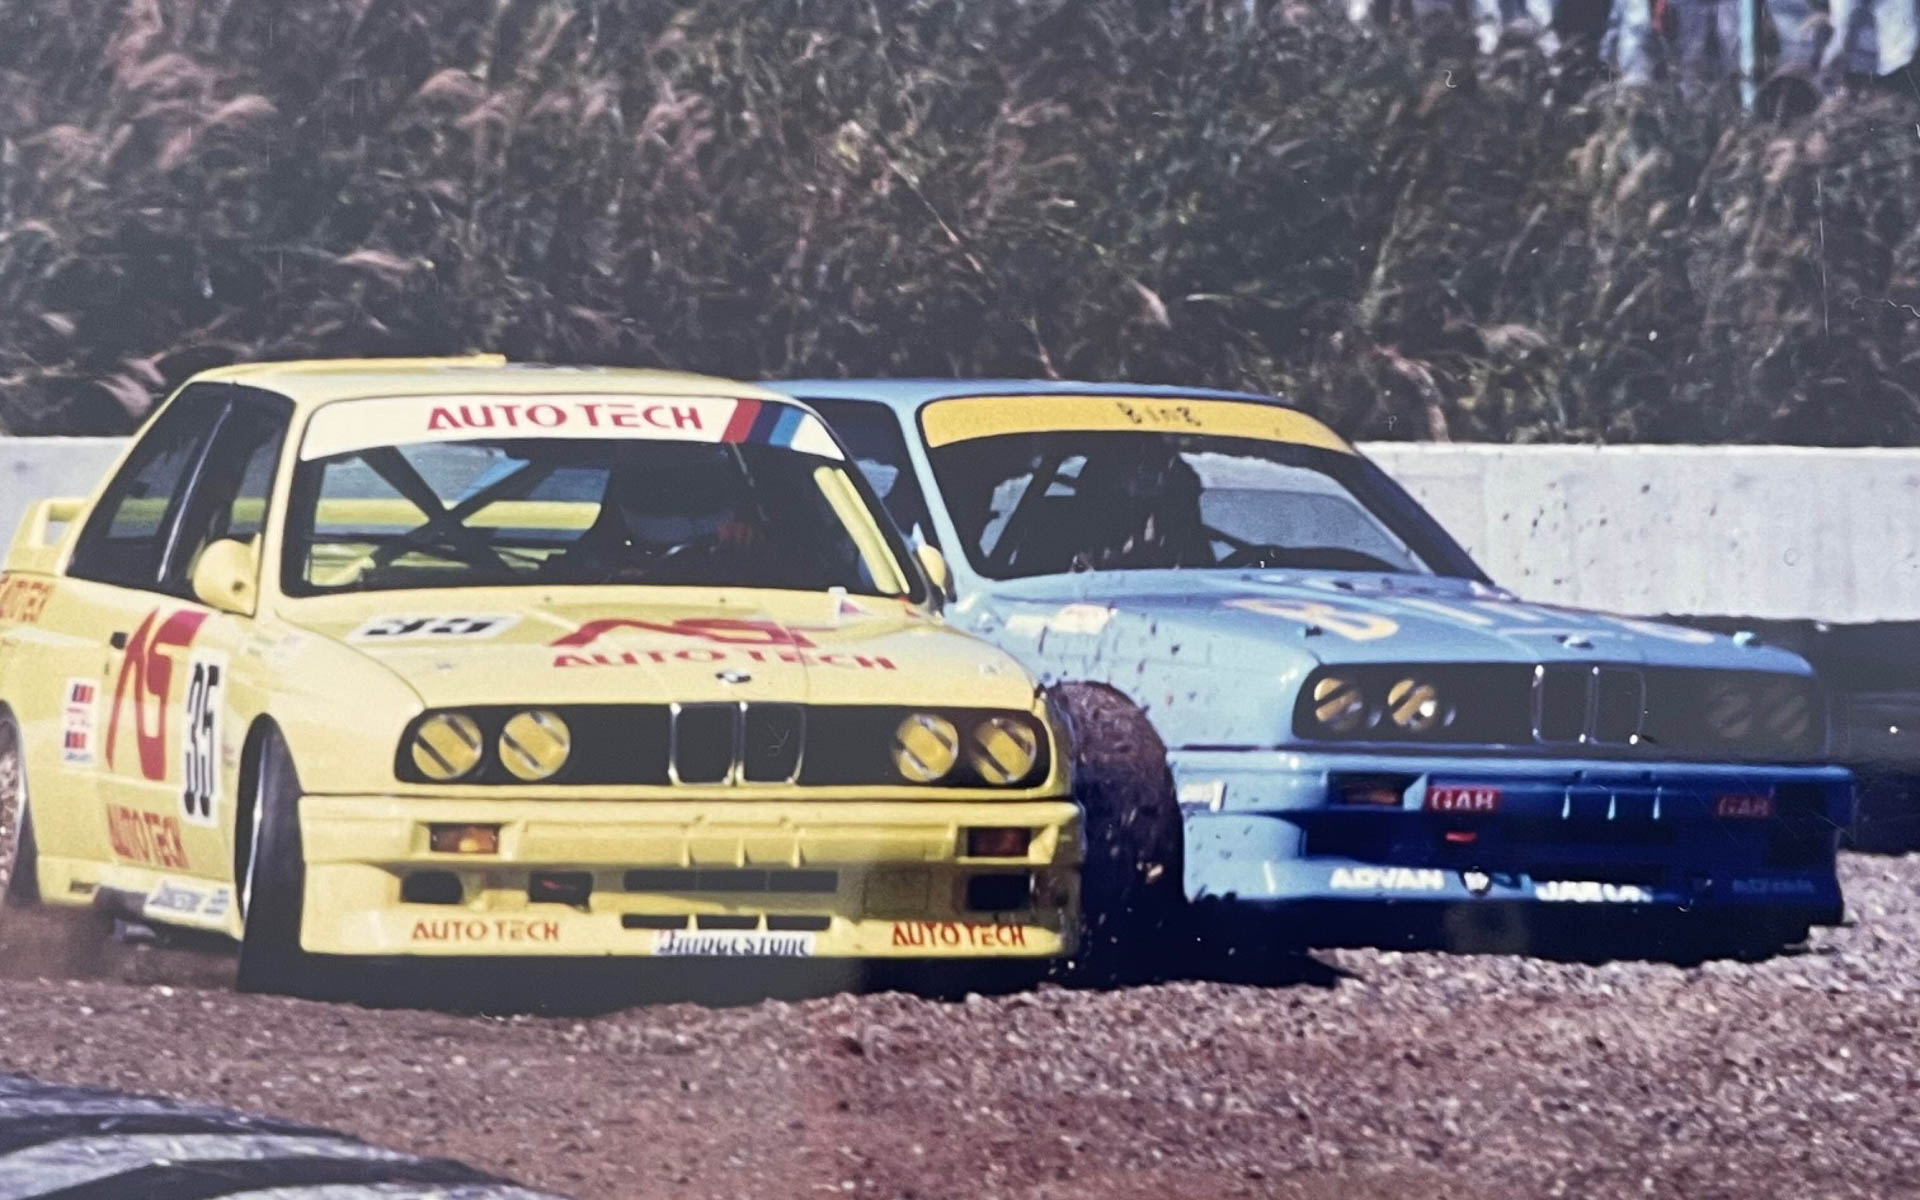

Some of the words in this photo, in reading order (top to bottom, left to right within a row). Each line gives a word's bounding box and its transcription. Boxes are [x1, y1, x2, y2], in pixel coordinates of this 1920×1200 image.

[427, 404, 567, 430] AUTO
[574, 404, 703, 430] TECH
[553, 651, 727, 667] AUTO
[743, 650, 897, 670] TECH
[1329, 867, 1445, 891] ADVAN
[412, 920, 488, 941] AUTO
[495, 920, 560, 941] TECH
[892, 920, 960, 947] AUTO
[961, 920, 1026, 947] TECH
